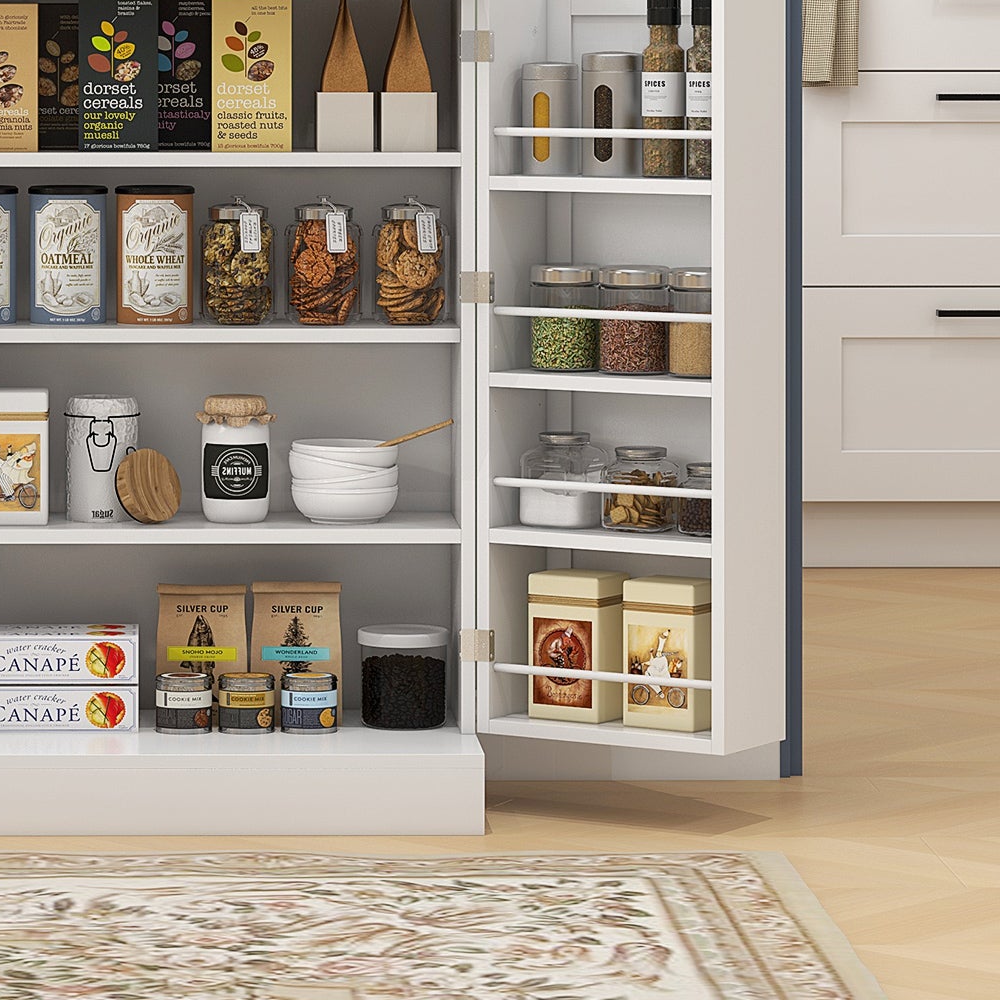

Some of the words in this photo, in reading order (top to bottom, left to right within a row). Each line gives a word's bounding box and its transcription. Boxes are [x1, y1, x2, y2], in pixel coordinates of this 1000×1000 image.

[83, 82, 136, 95] dorset
[158, 81, 197, 94] orset
[217, 82, 270, 95] dorset
[83, 96, 143, 109] cereals
[158, 96, 203, 108] ereals
[216, 96, 276, 109] cereals
[84, 112, 102, 120] our
[105, 111, 136, 122] lovely
[158, 110, 210, 120] ntasticaly
[217, 111, 253, 120] classic
[256, 111, 287, 121] fruits,
[84, 121, 123, 131] organic
[218, 121, 257, 130] roasted
[259, 122, 284, 130] nuts
[84, 131, 120, 140] muesli
[217, 131, 226, 140] &
[228, 131, 258, 140] seeds
[39, 212, 92, 250] Organic
[126, 212, 180, 250] Organic
[41, 253, 94, 265] OATMEAL
[126, 255, 155, 264] WHOLE
[156, 255, 184, 264] WHEAT
[176, 605, 207, 613] SILVER
[210, 605, 228, 613] CUP
[6, 644, 31, 655] water
[33, 643, 66, 654] cracker
[6, 694, 31, 705] water
[33, 693, 66, 704] cracker
